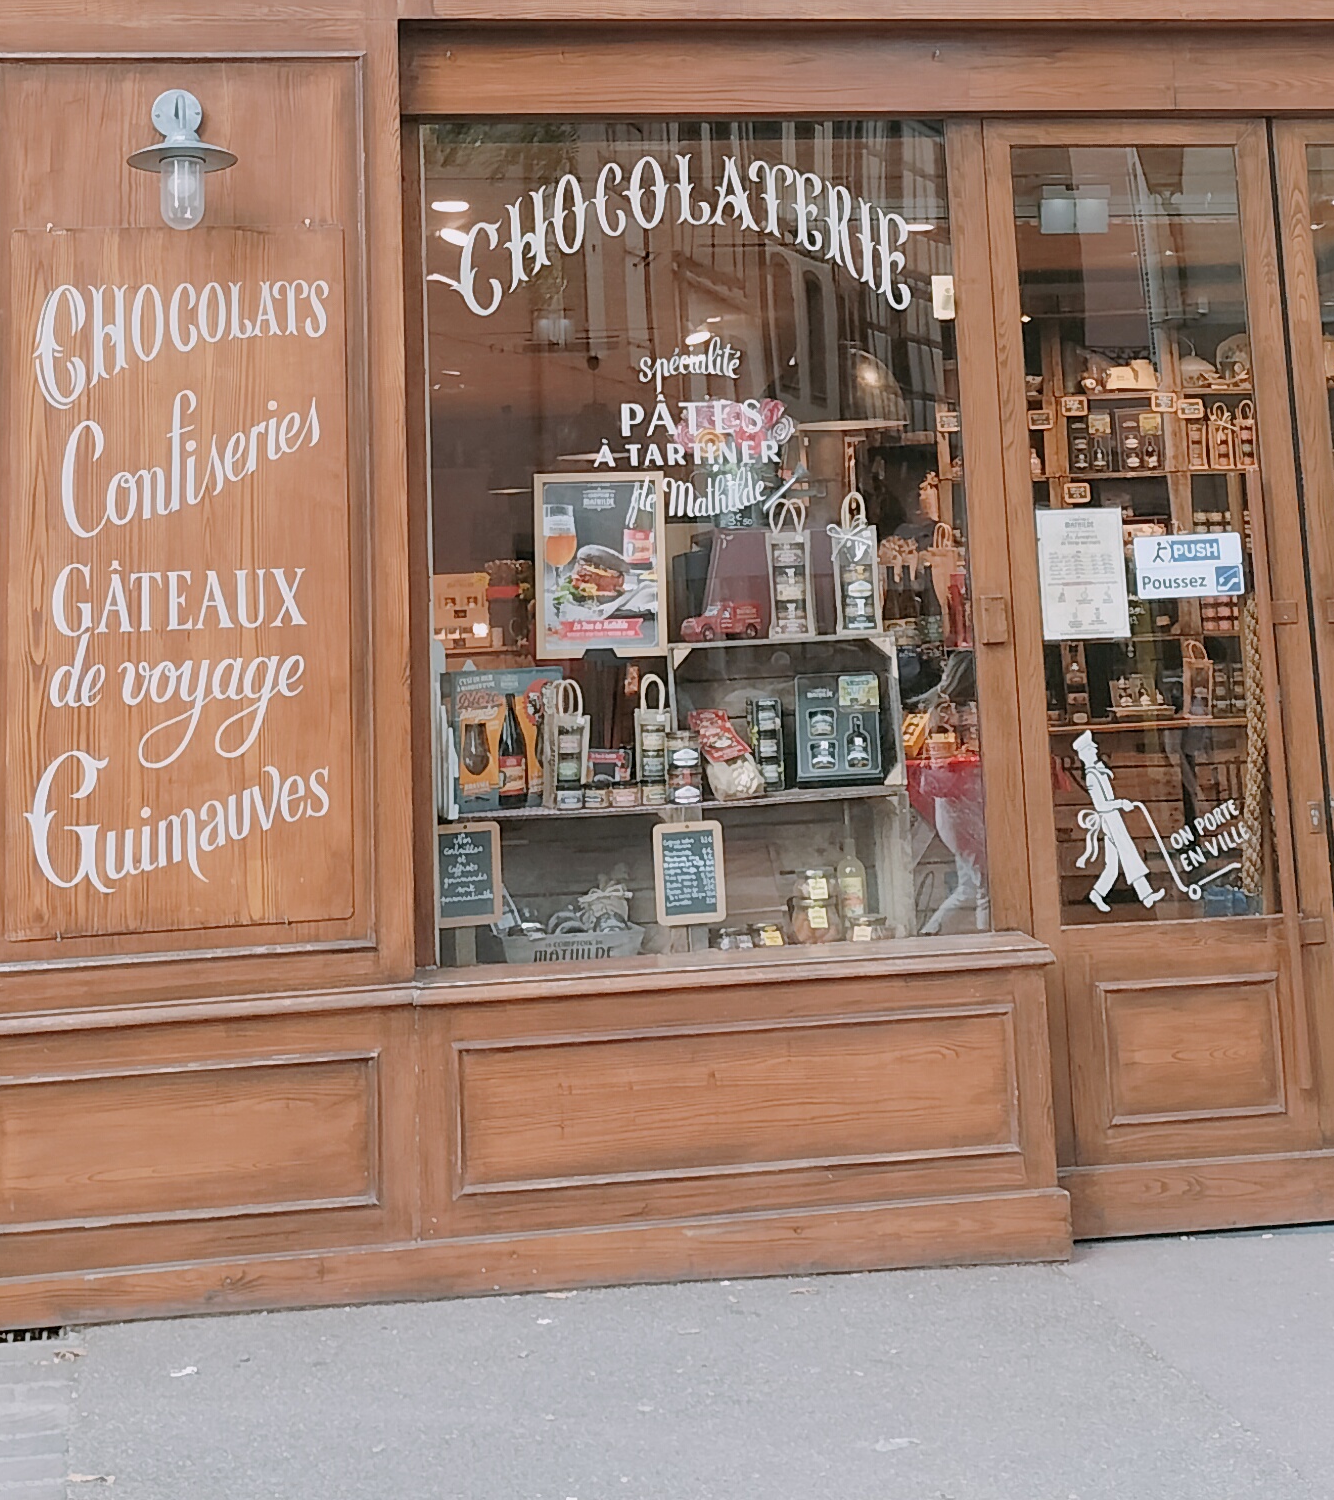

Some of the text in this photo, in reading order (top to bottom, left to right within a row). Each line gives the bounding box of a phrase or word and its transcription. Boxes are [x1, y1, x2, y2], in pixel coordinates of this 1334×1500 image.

[449, 153, 912, 316] CHOCOLATERIE
[32, 280, 329, 410] CHOCOLATS
[638, 337, 741, 394] spécialité
[620, 394, 763, 437] PÂTES
[61, 389, 321, 538] Confiseries
[593, 438, 781, 467] À TARTINER
[639, 466, 767, 517] de Mathilde
[1173, 542, 1218, 559] PUSH
[52, 560, 307, 637] GÂTEAUX
[1142, 575, 1208, 591] Poussez
[49, 630, 306, 768] de voyage
[23, 750, 330, 894] Guimauves
[1170, 799, 1240, 849] ON PORTE
[1180, 821, 1251, 872] EN VILLE
[533, 946, 614, 963] MATHILDE
